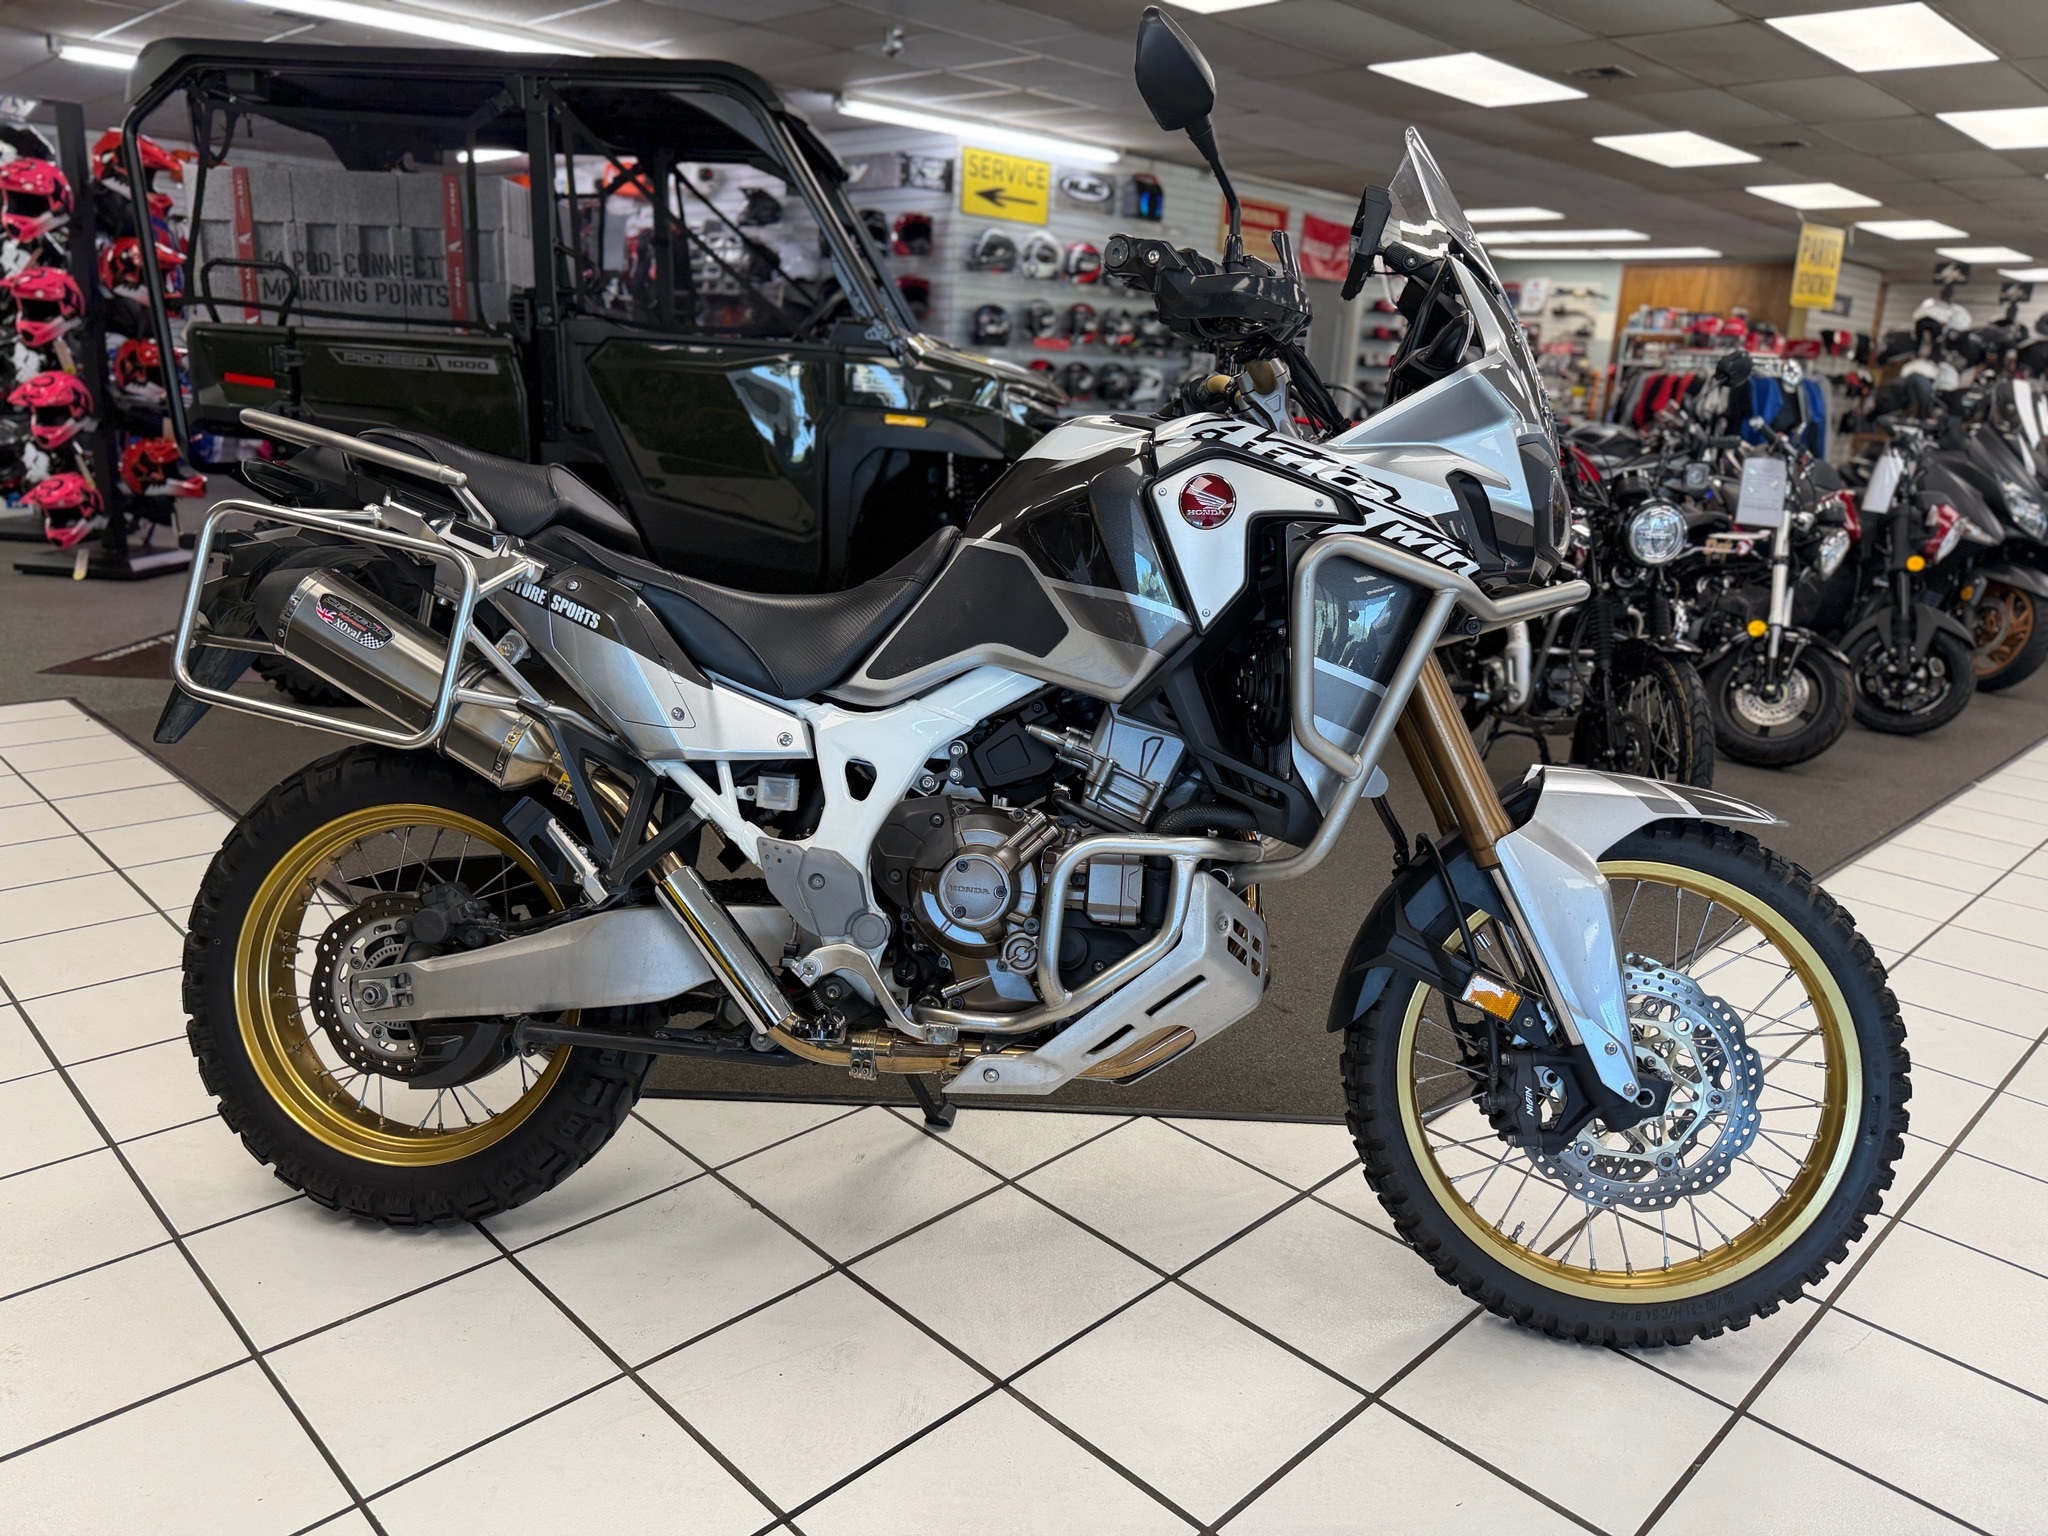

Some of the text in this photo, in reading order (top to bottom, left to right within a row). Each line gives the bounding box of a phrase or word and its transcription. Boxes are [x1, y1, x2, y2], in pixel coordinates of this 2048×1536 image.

[968, 153, 1046, 190] SERVICE
[376, 282, 449, 307] POINTS
[343, 352, 489, 370] PIONEER 1000
[506, 581, 601, 629] NTURE SPORTS
[333, 618, 362, 640] XOval
[949, 885, 991, 895] HONDA
